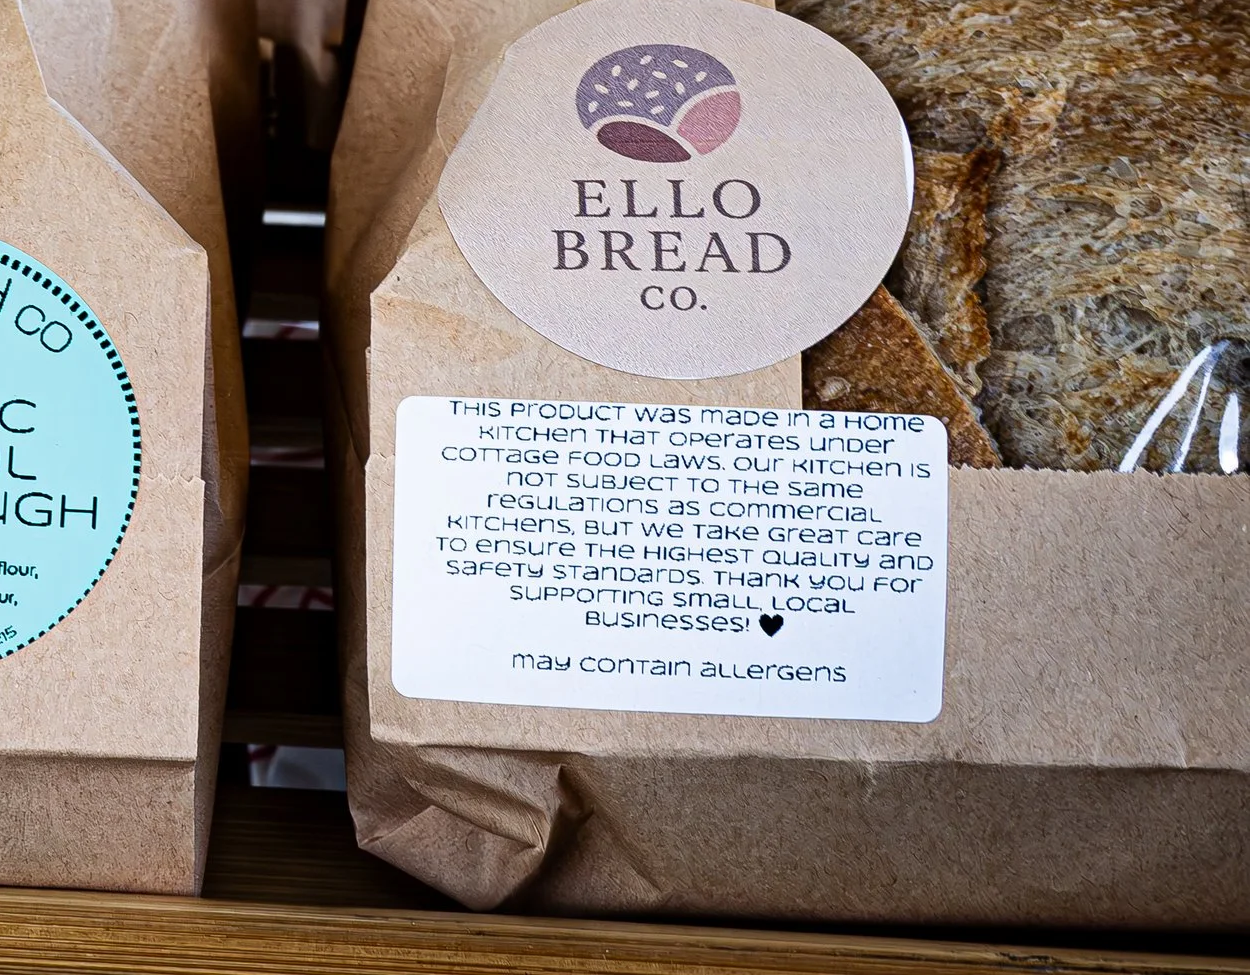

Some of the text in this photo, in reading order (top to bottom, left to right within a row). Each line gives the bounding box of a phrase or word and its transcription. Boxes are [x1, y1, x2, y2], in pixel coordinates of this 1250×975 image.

[572, 178, 762, 220] ELLO
[551, 229, 792, 274] BREAD
[640, 285, 708, 311] CO.
[14, 304, 73, 353] co
[448, 400, 502, 418] THIS
[568, 450, 641, 468] FOOD
[910, 462, 931, 479] IS
[686, 477, 720, 494] TO
[435, 536, 468, 553] TO
